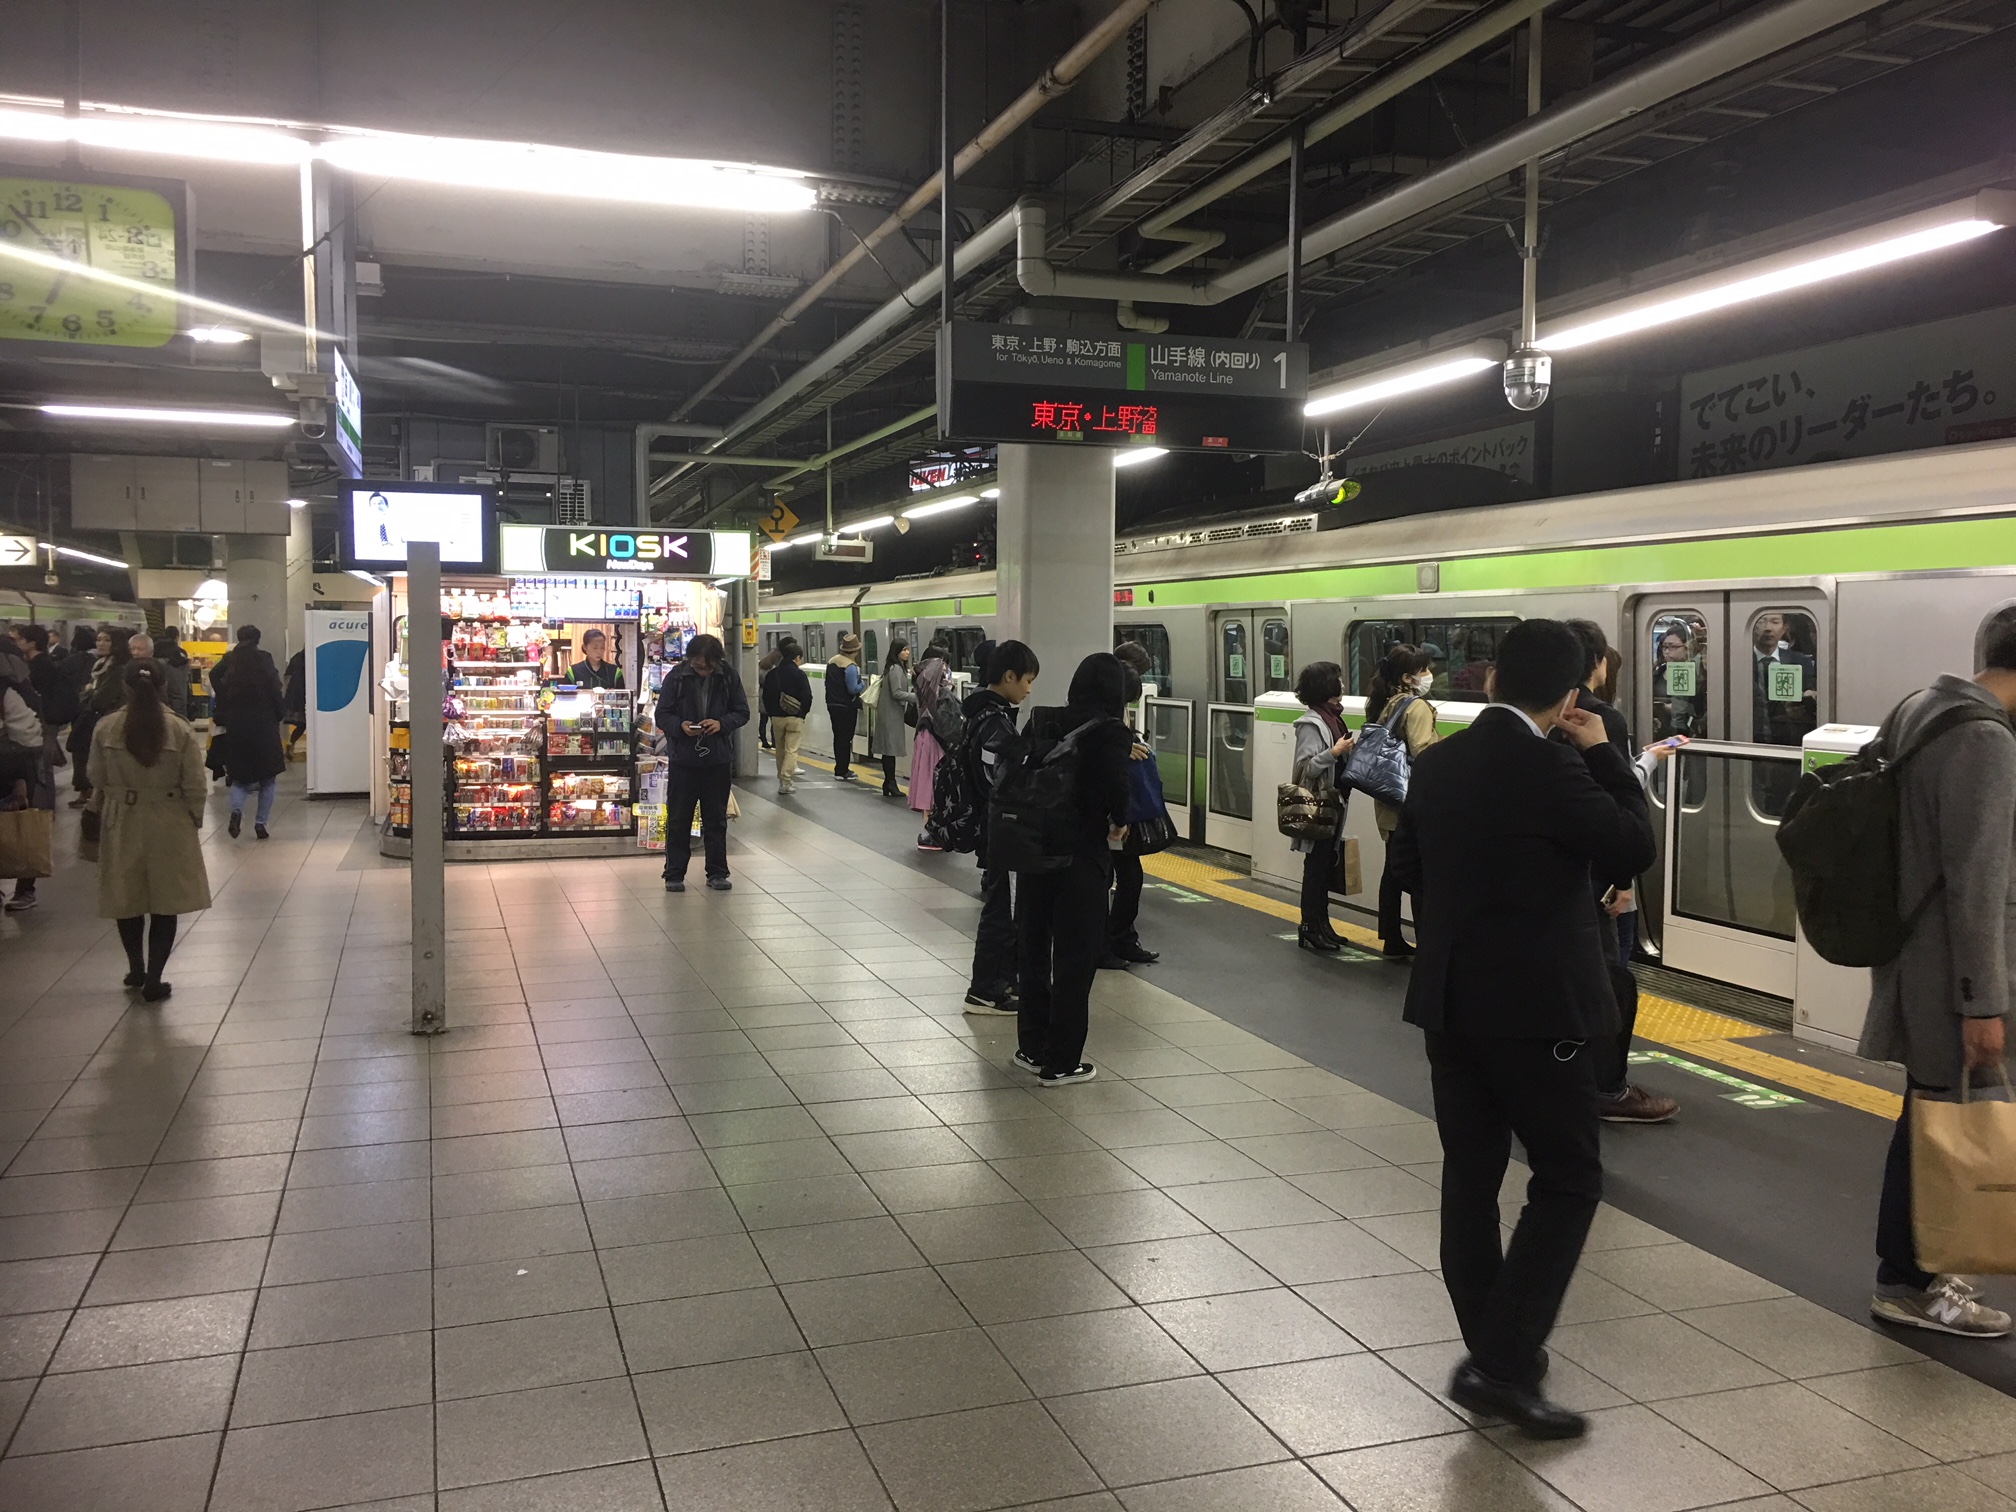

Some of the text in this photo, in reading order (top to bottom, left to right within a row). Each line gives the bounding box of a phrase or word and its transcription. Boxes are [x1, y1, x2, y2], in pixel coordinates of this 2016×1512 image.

[23, 199, 49, 219] 11
[53, 193, 83, 212] 12
[98, 203, 111, 222] 1
[141, 260, 159, 278] 3
[128, 292, 146, 311] 4
[28, 305, 47, 324] 7
[62, 313, 82, 332] 6
[96, 309, 116, 329] 5
[991, 334, 1122, 357] 東京・上野・駒込方面
[996, 352, 1008, 361] for
[1041, 355, 1064, 365] Ueno
[1074, 357, 1122, 369] Komagome
[1151, 369, 1234, 384] Yamanote Line
[1273, 352, 1287, 389] 1
[570, 533, 688, 558] KIOSK
[329, 621, 368, 630] acure
